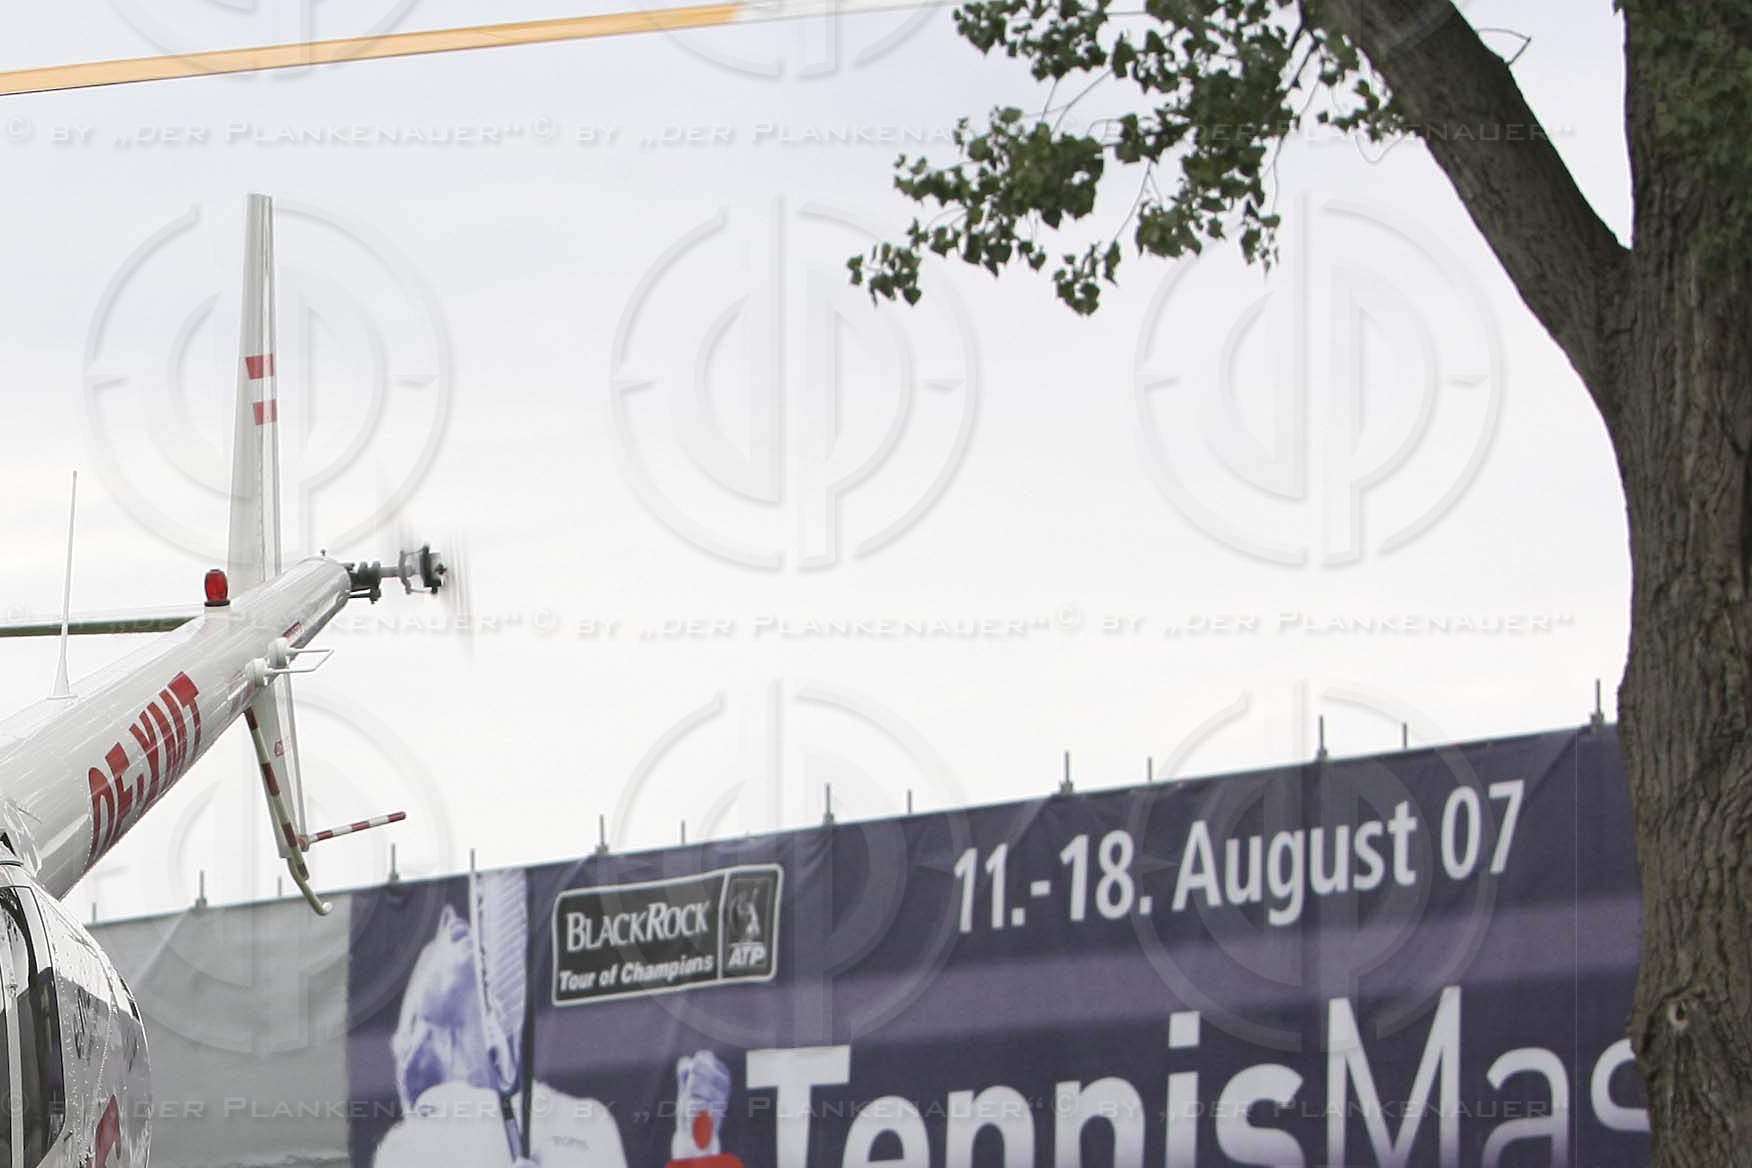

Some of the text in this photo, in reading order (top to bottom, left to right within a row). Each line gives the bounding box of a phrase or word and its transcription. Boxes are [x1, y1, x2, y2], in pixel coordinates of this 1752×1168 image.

[1173, 800, 1418, 927] August
[1441, 780, 1525, 882] 07
[560, 954, 714, 992] Tour of Champions
[728, 944, 766, 968] ATP
